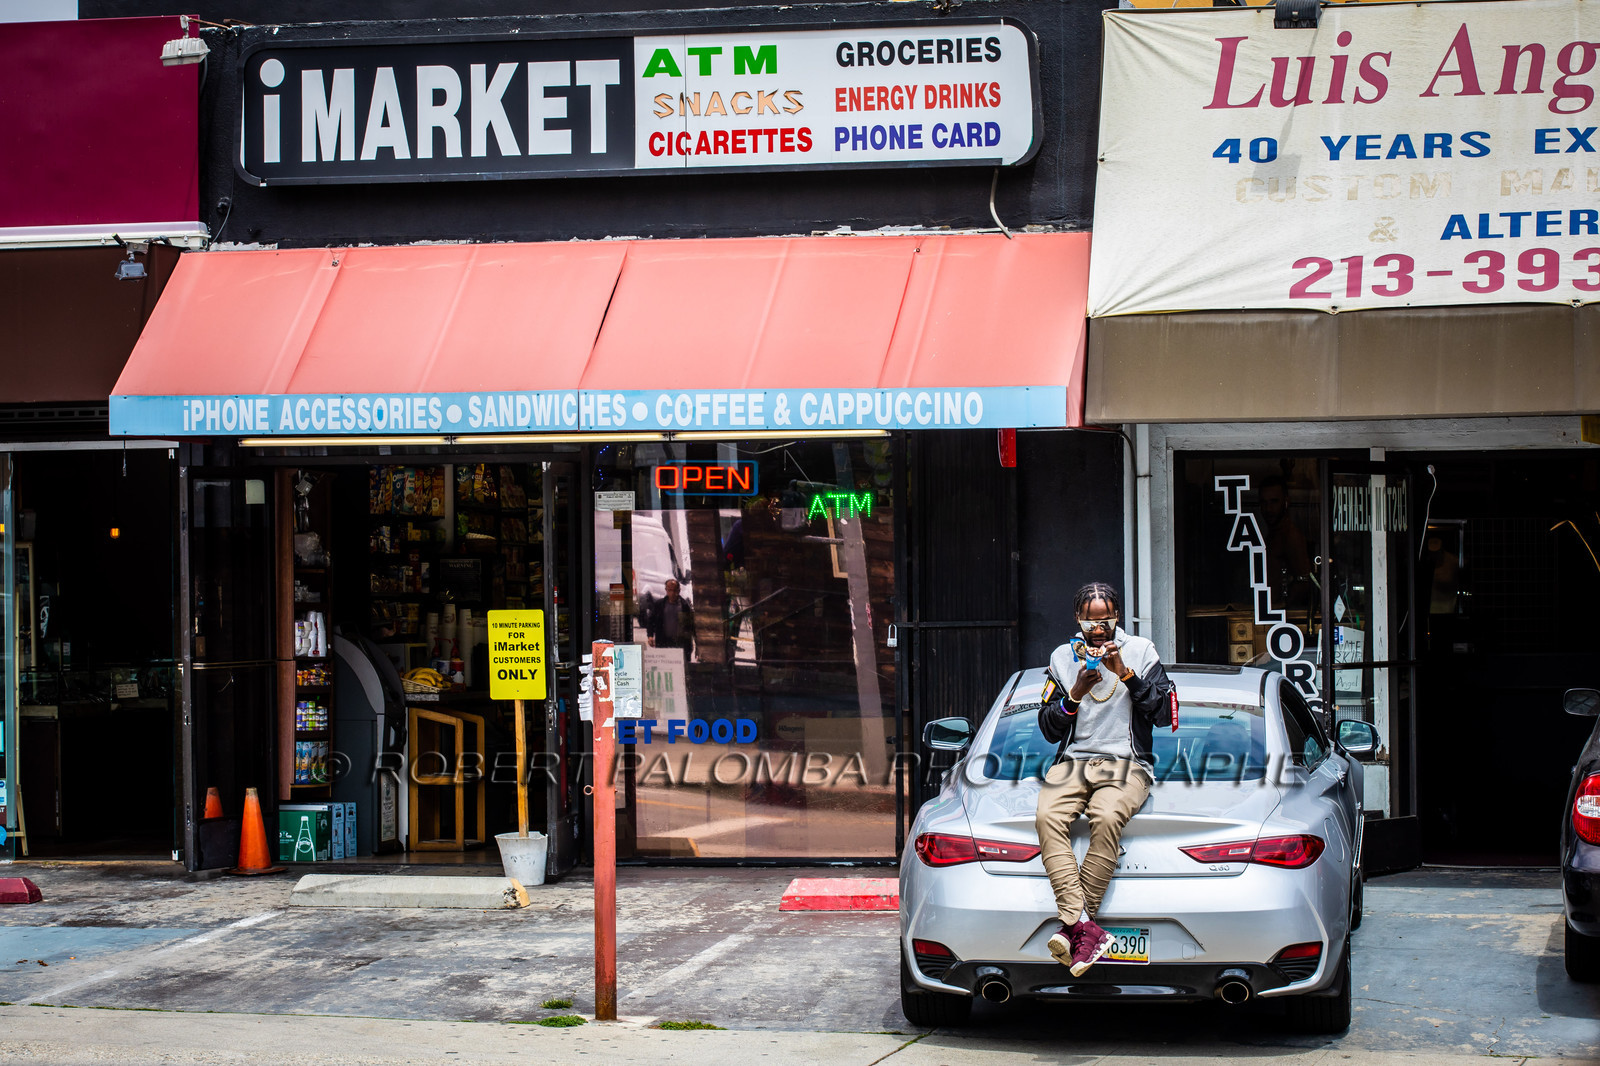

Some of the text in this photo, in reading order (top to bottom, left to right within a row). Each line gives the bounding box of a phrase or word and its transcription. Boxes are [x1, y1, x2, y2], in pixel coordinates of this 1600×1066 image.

[642, 44, 778, 78] ATM
[836, 36, 1002, 68] GROCERIES
[1202, 30, 1393, 110] Luis
[653, 88, 805, 119] SNACKS
[835, 81, 1002, 113] ENERGY DRINKS
[648, 126, 813, 157] CIGARETTES
[834, 121, 1001, 152] PHONE CARD
[1212, 126, 1599, 164] 40 YEARS EX
[1236, 170, 1453, 204] CUSTOM
[1440, 209, 1600, 241] ALTER
[182, 390, 984, 432] iPHONE ACCESSORIES SANDWICHES COFFEE & CAPPUCCINO
[655, 465, 751, 490] OPEN
[808, 492, 873, 519] ATM
[493, 656, 541, 664] CUSTOMERS
[494, 641, 540, 651] iMarket
[497, 669, 538, 680] ONLY
[615, 718, 758, 745] ET FOOD
[1106, 935, 1147, 955] 6390
